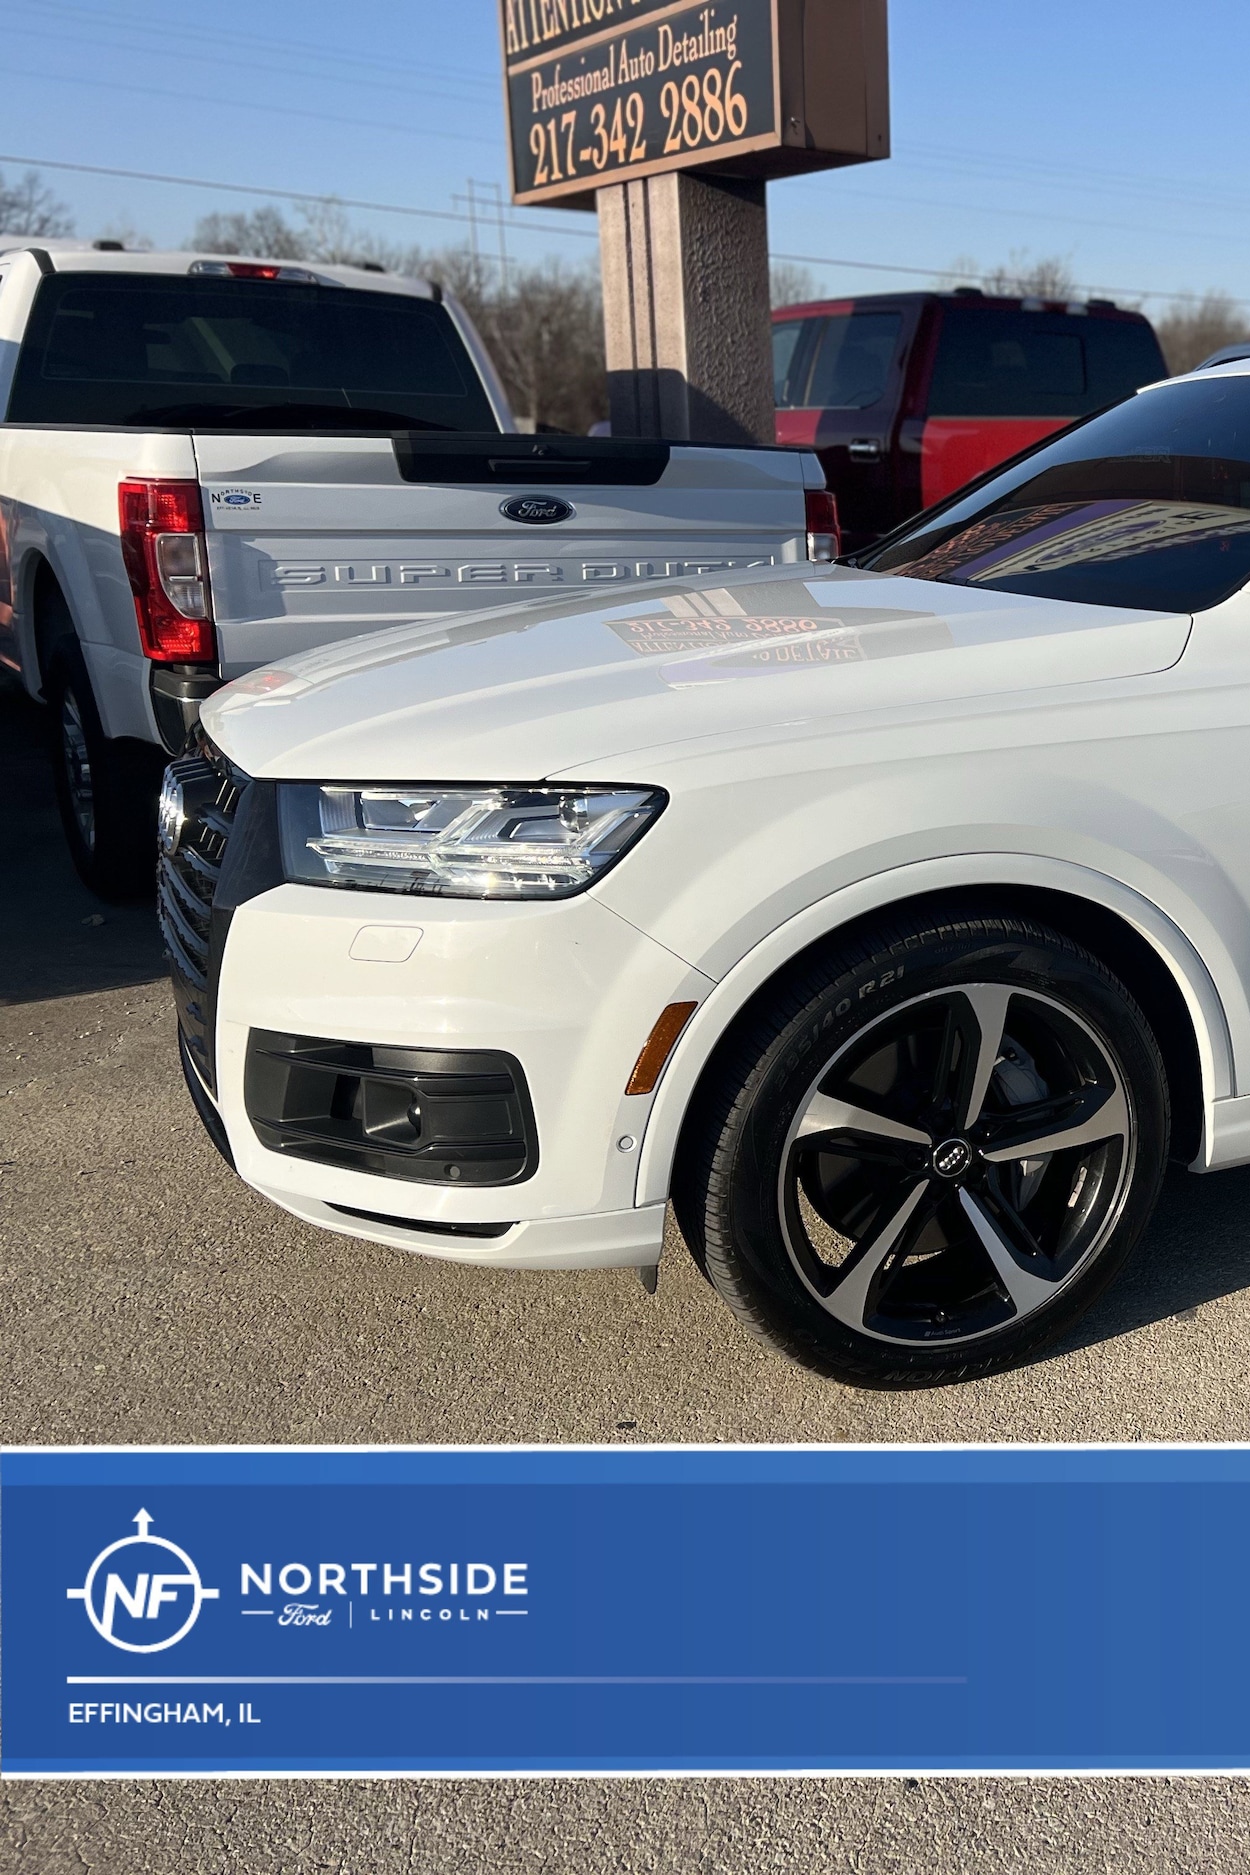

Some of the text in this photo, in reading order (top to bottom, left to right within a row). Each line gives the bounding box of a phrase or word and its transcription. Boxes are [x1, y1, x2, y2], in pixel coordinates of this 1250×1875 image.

[507, 0, 623, 55] ATTEN
[531, 11, 738, 113] Professional Auto Detailing
[529, 61, 749, 187] 217-342 2886
[517, 500, 558, 518] Ford
[273, 563, 564, 586] SUPER
